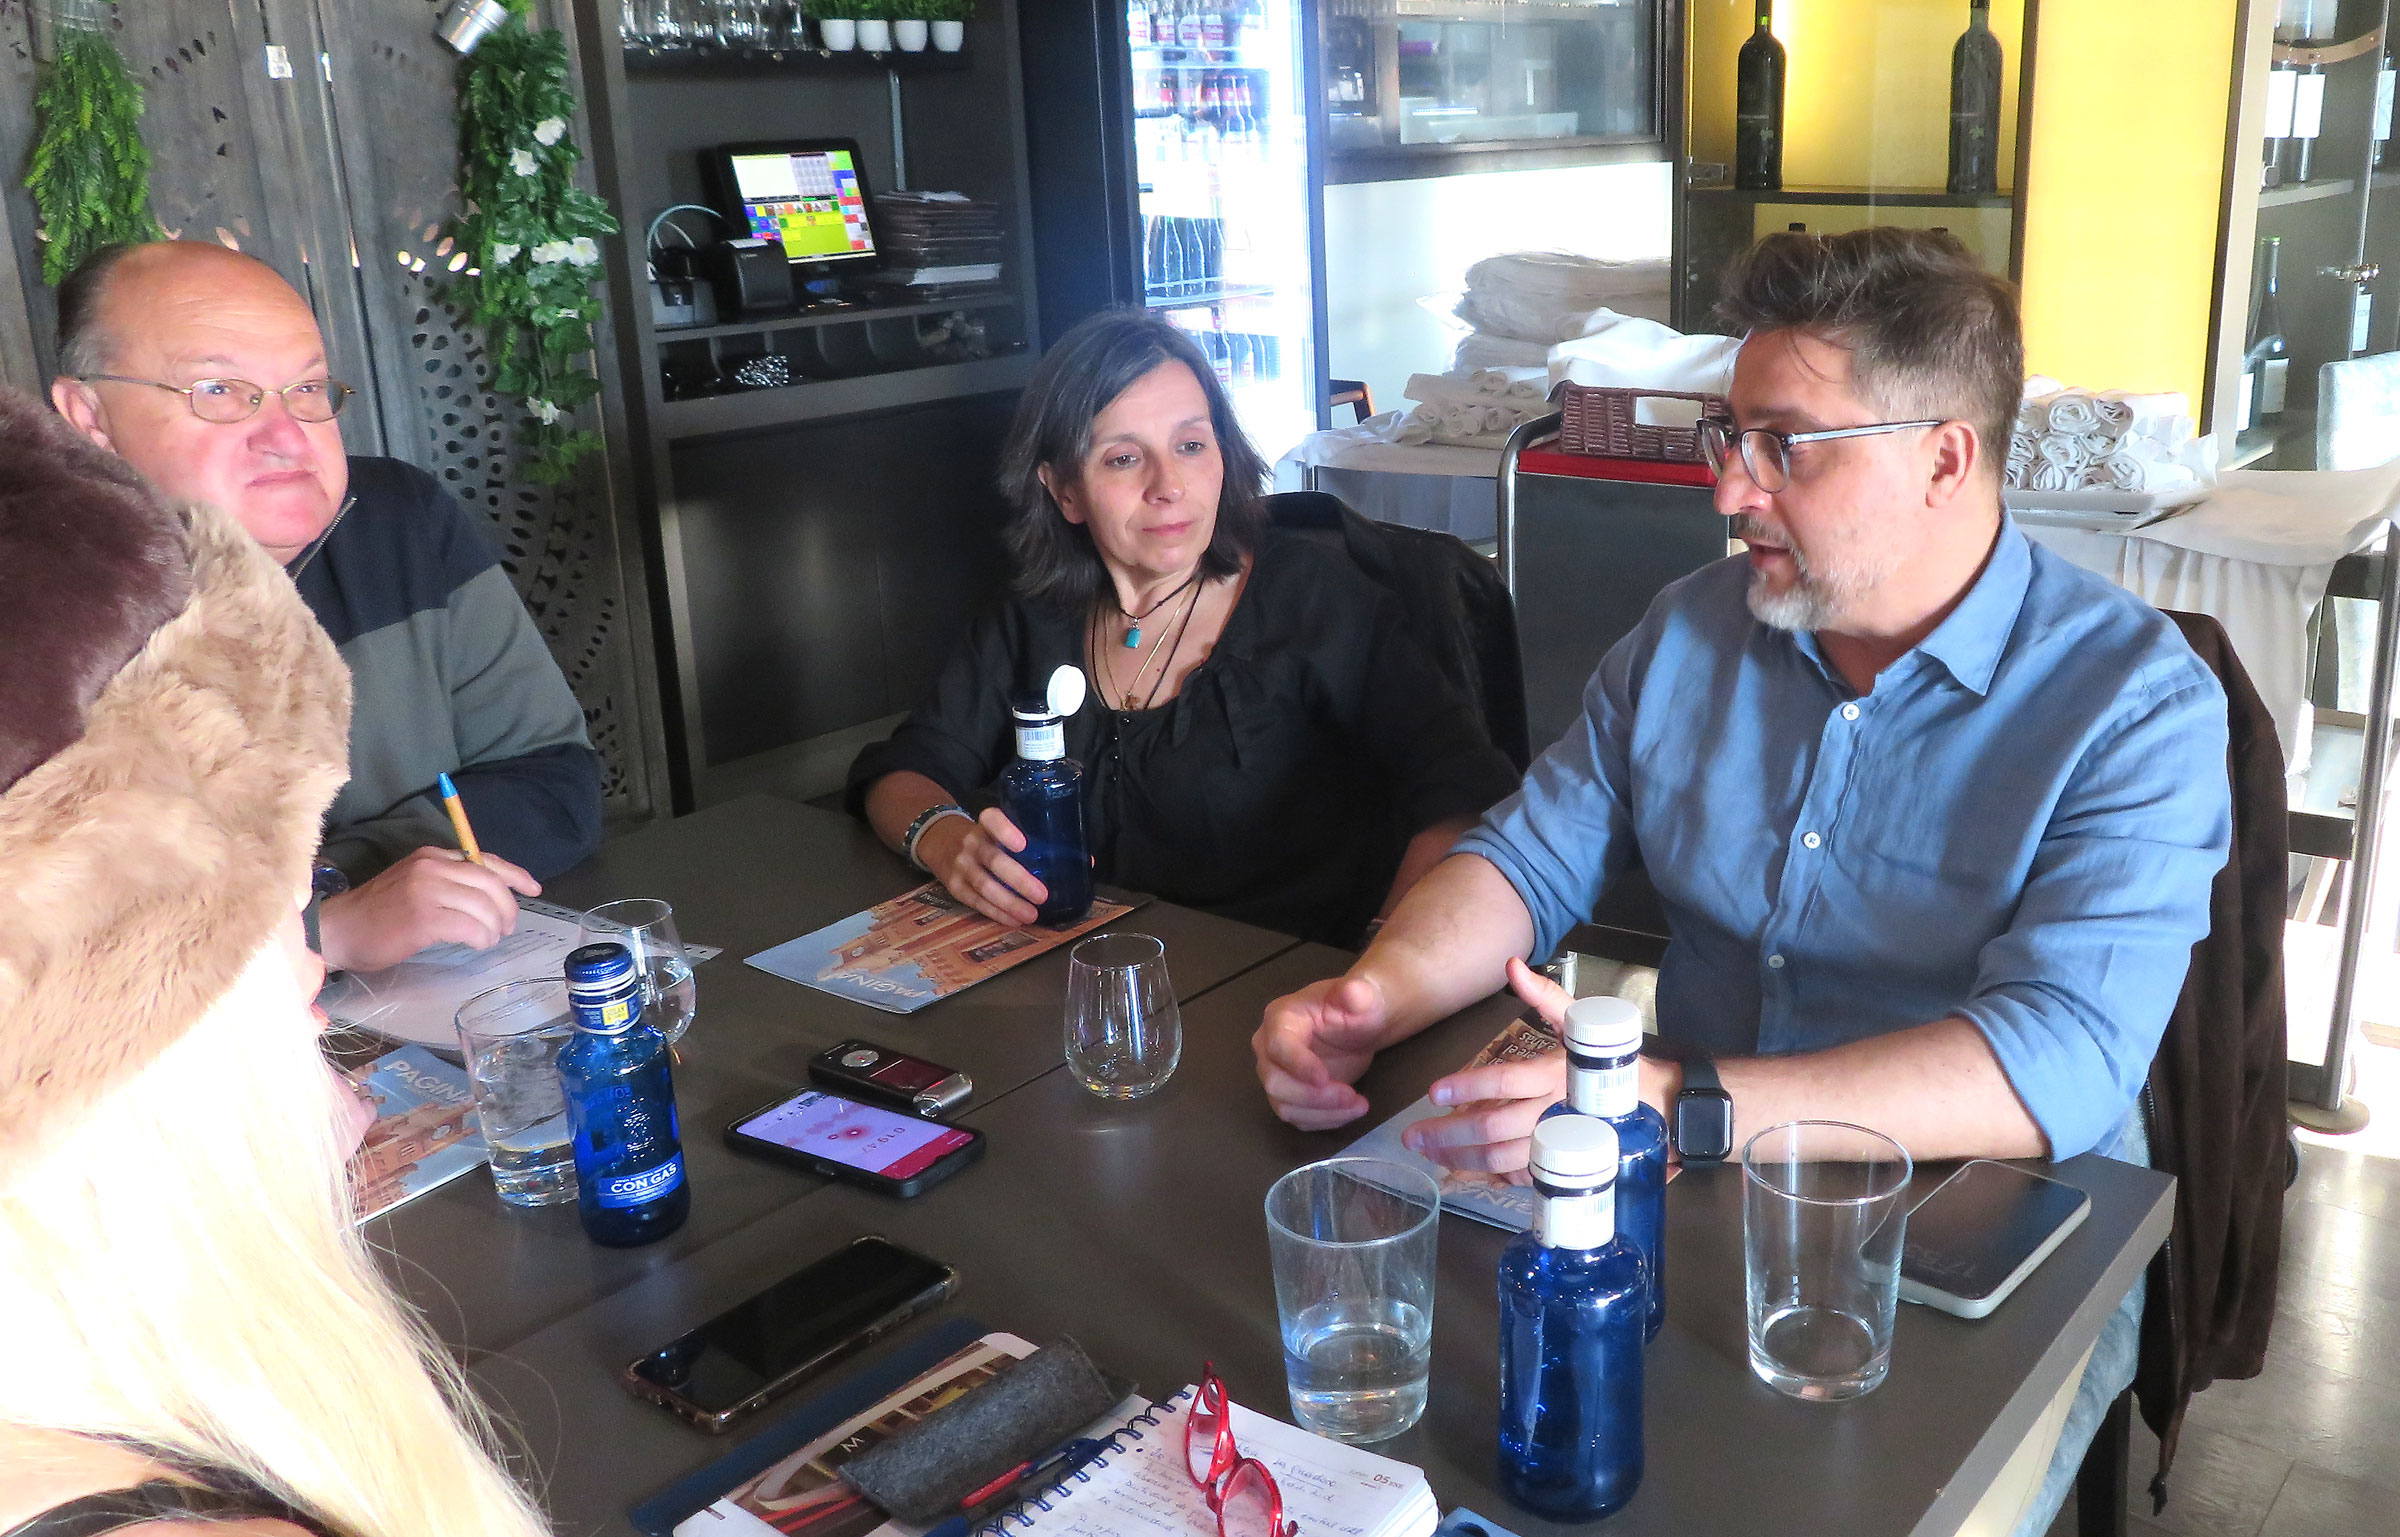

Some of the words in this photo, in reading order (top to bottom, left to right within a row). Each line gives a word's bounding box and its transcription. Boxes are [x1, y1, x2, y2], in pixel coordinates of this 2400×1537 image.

[611, 1177, 648, 1193] CON
[651, 1163, 677, 1184] GAS
[1373, 1473, 1391, 1485] 05
